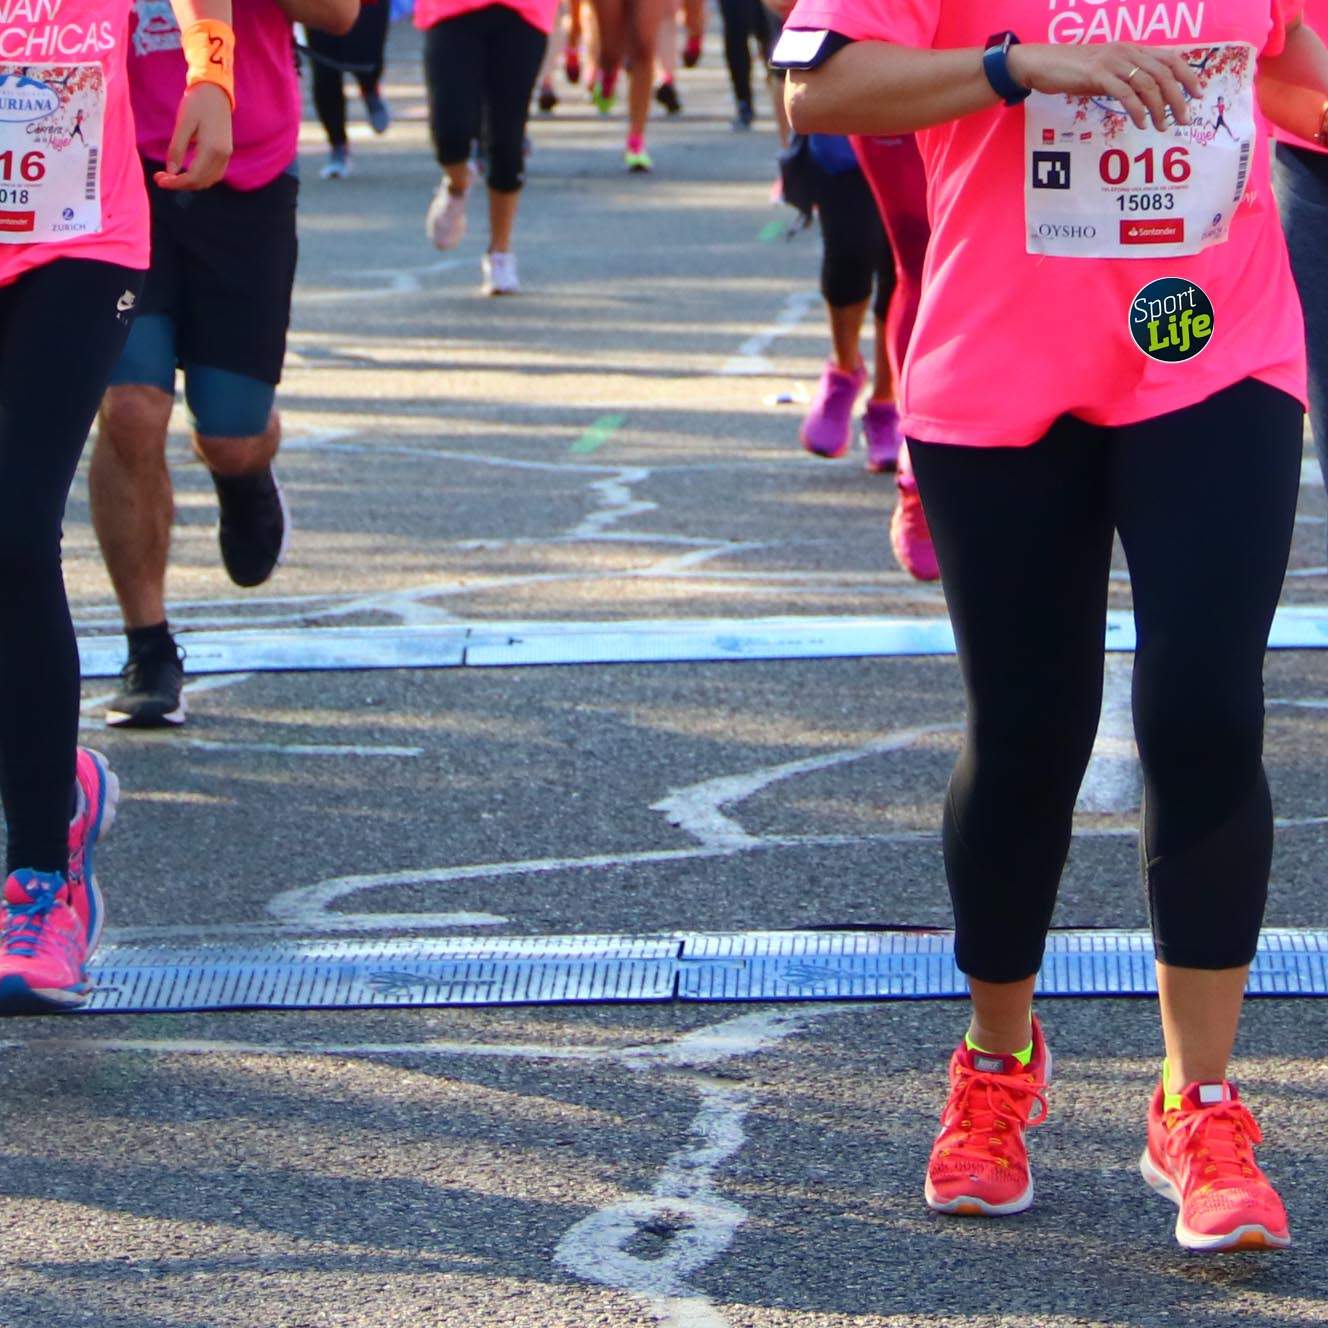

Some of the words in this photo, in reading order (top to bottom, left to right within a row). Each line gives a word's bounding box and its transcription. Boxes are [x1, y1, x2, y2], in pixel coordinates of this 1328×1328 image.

[1048, 2, 1205, 42] GANAN
[1099, 146, 1192, 186] 016
[1116, 193, 1175, 211] 15083
[1039, 224, 1096, 239] OYSHO
[1139, 229, 1177, 237] Santander
[1134, 286, 1196, 327] Sport
[1147, 310, 1213, 353] Life
